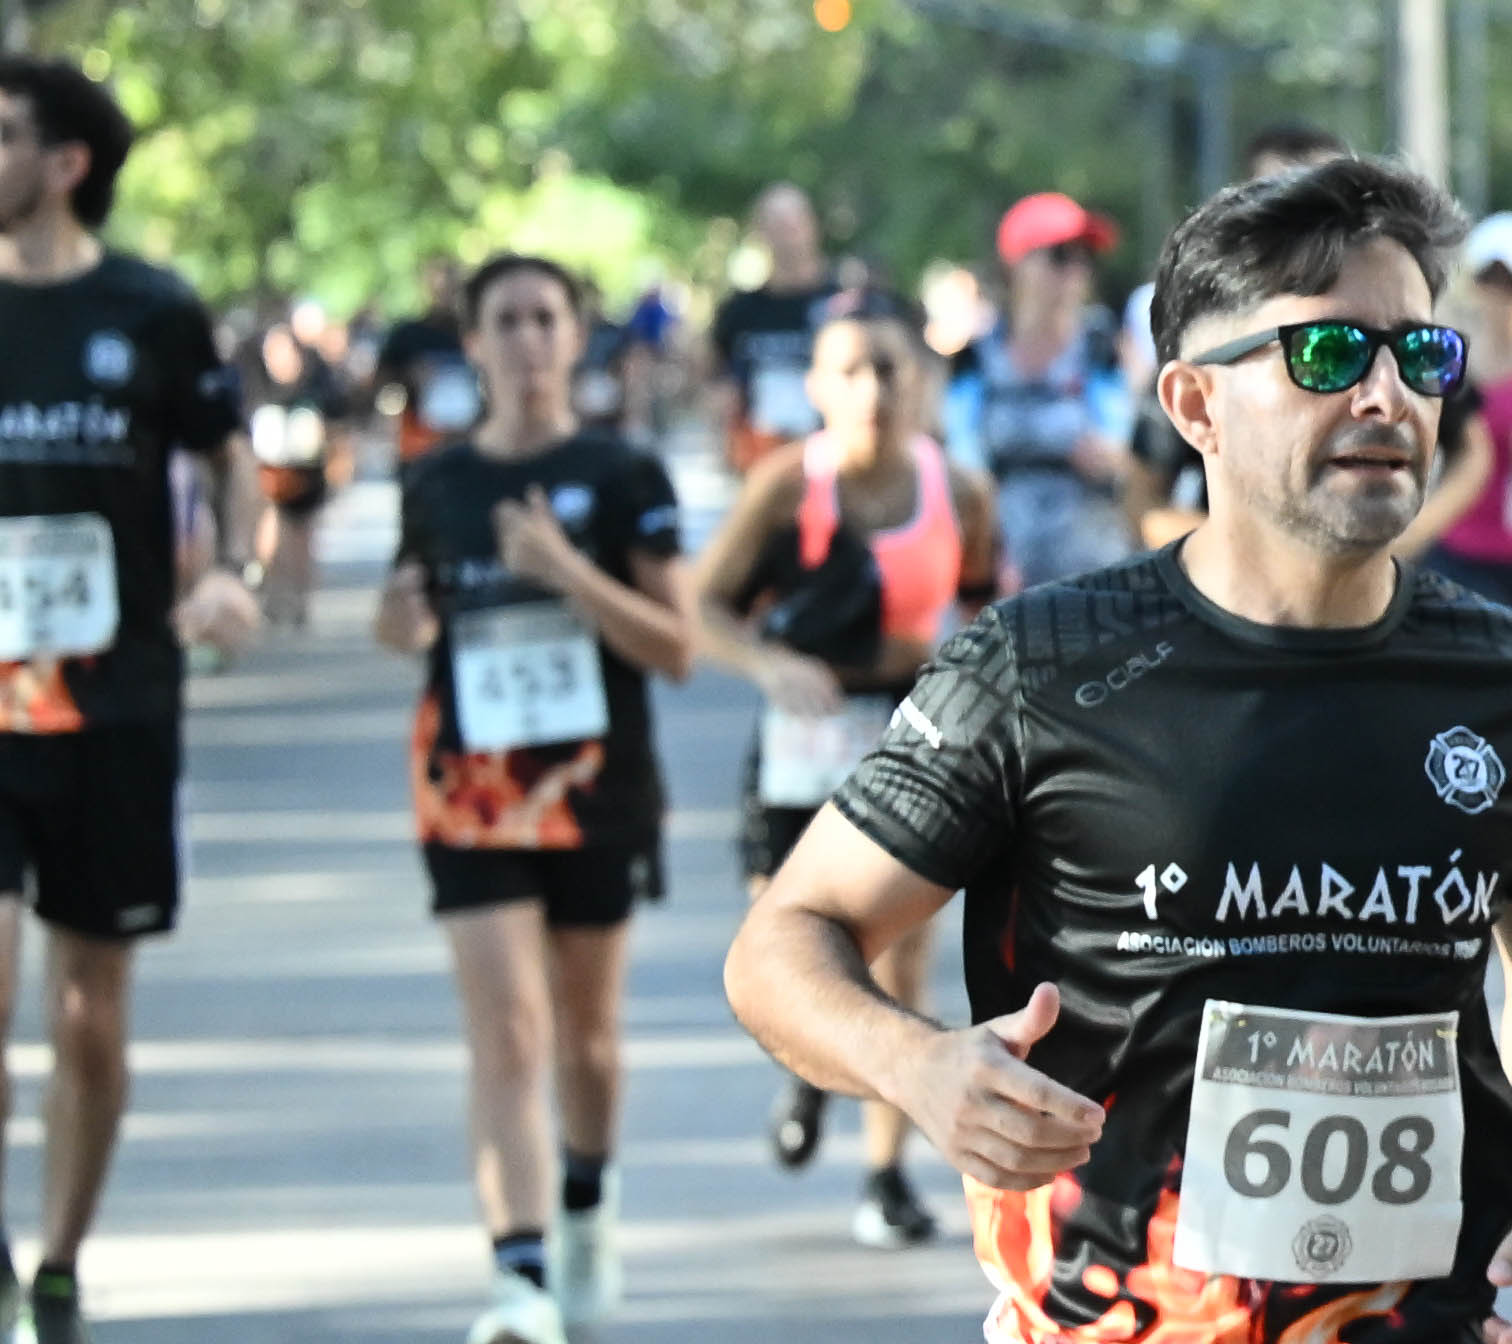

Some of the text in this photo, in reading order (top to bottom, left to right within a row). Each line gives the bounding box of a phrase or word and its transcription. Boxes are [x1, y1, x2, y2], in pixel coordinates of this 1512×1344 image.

[1452, 753, 1480, 780] 27
[1215, 848, 1499, 925] MARATÓN
[1117, 930, 1226, 958] ASOCIACIÓN
[1230, 932, 1326, 957] BOMBEROS
[1286, 1030, 1435, 1075] MARATÓN
[1223, 1108, 1435, 1205] 608
